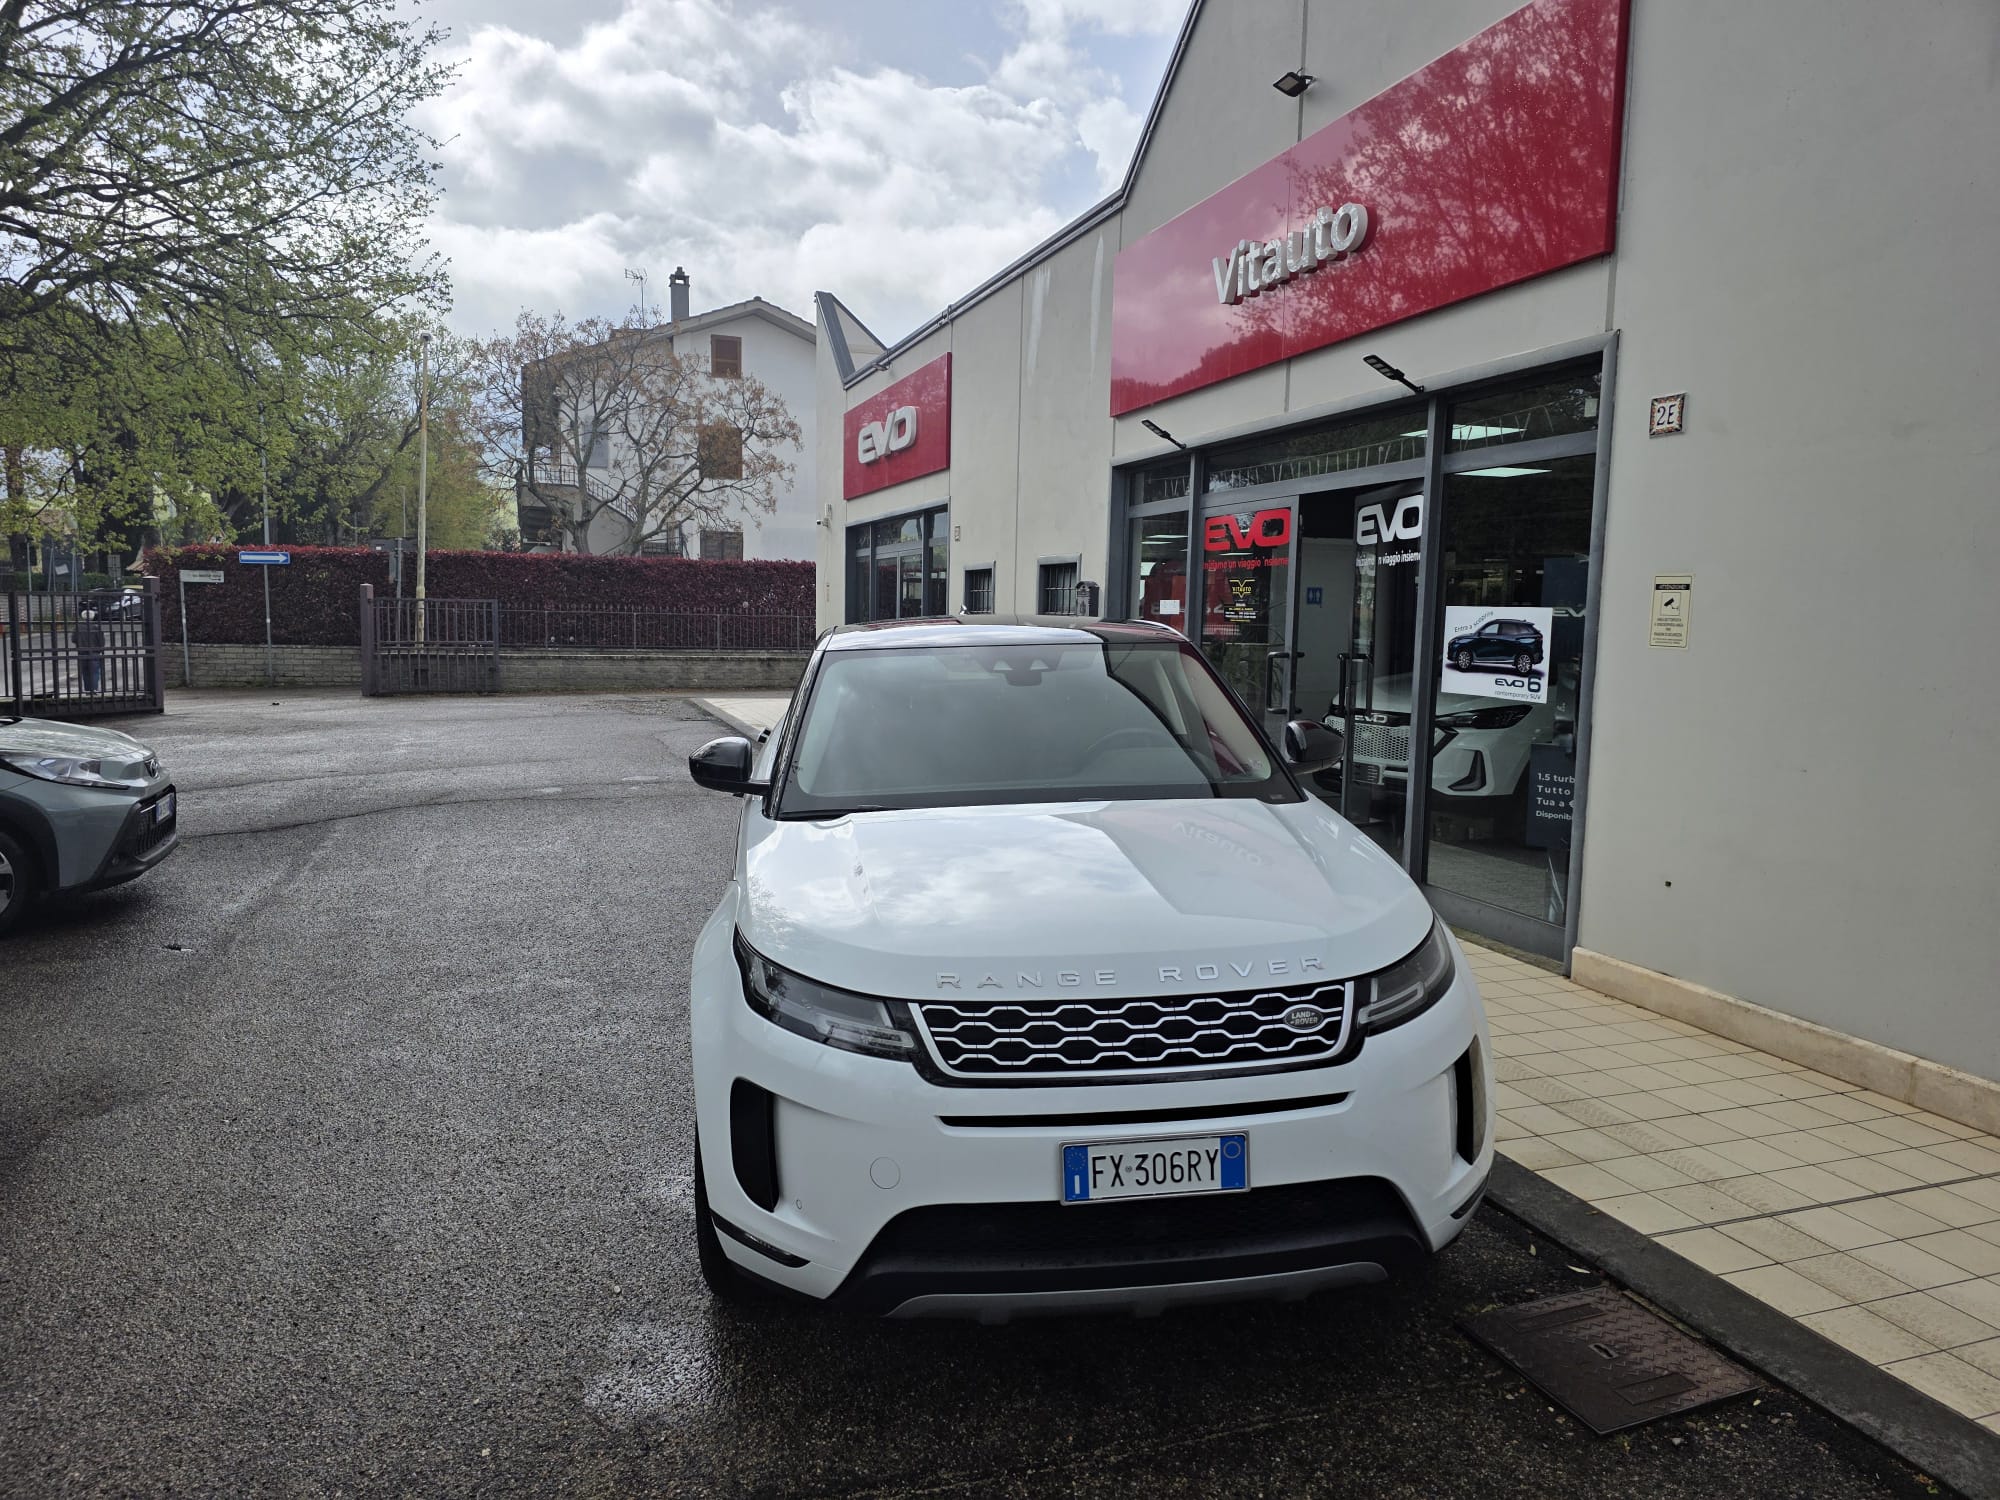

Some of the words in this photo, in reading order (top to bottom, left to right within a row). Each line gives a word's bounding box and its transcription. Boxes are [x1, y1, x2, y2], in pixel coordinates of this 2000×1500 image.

[1212, 202, 1368, 304] Vitauto
[1657, 404, 1676, 425] 2E
[858, 406, 917, 464] EVO
[1357, 494, 1424, 545] EVO
[1205, 509, 1290, 551] EVO
[1551, 607, 1586, 618] EV
[1495, 678, 1525, 688] EVO
[1528, 676, 1541, 693] 6
[1538, 772, 1550, 781] 1.5
[1536, 785, 1571, 795] Tutto
[1536, 797, 1556, 806] Tua
[936, 969, 1117, 989] RANGE
[1158, 956, 1324, 983] ROVER
[1291, 1011, 1311, 1019] LAND
[1295, 1016, 1318, 1025] ROVER
